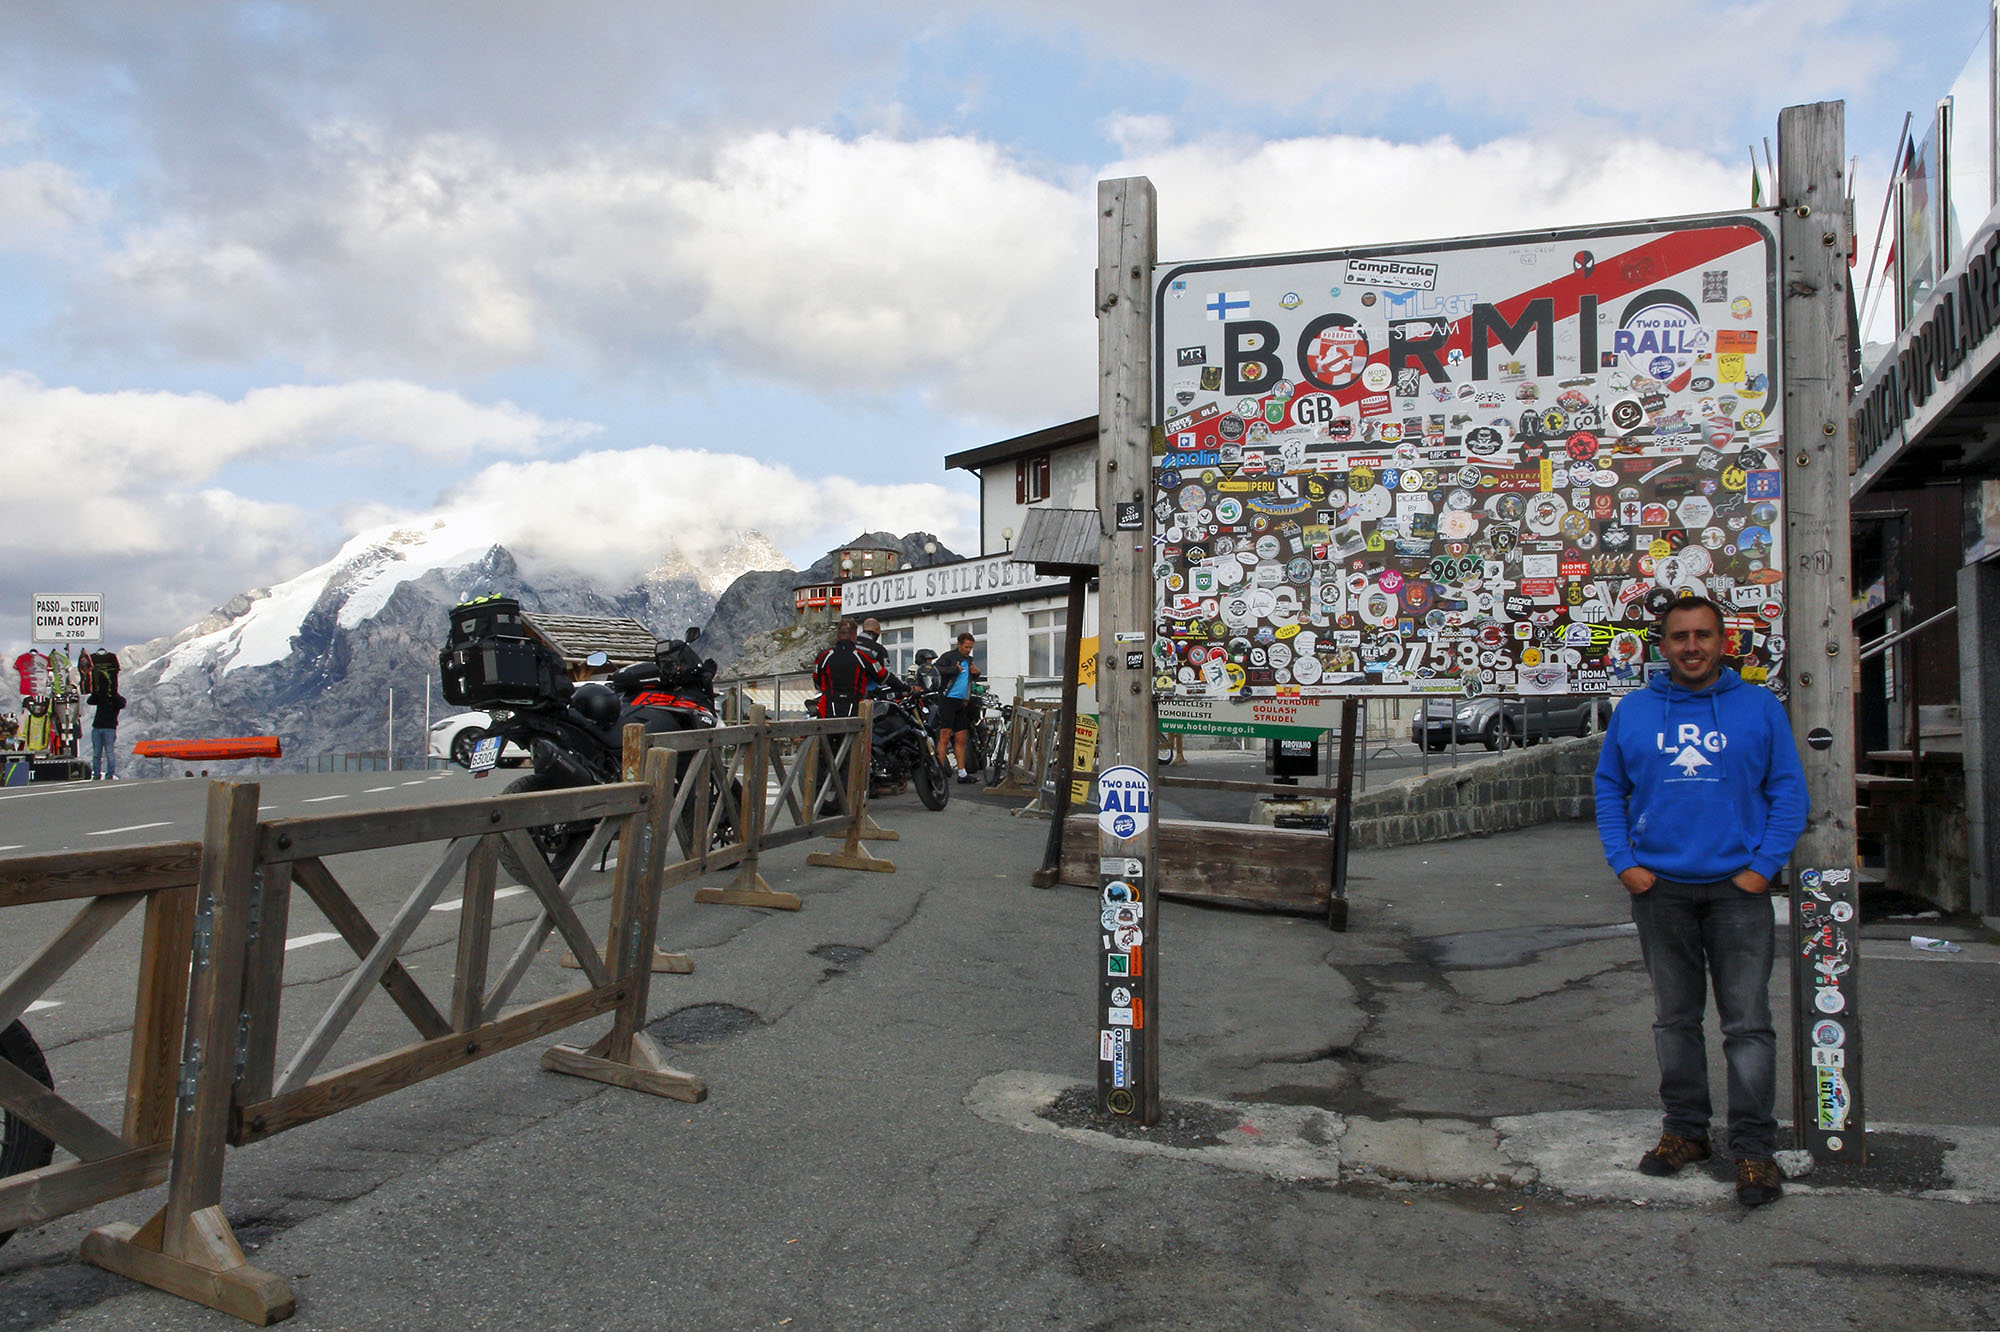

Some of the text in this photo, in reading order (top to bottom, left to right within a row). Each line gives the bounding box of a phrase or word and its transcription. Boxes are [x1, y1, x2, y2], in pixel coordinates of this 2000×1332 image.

[1348, 259, 1435, 277] CompBrake
[1636, 320, 1661, 328] TWO
[1614, 329, 1705, 358] RALL
[1181, 347, 1203, 360] MTR
[1856, 230, 2000, 469] BANCA POPOLARE
[1297, 396, 1333, 425] GB
[1429, 451, 1447, 459] MPC
[1349, 458, 1380, 467] MOTUL
[1251, 481, 1276, 492] PERU
[1499, 480, 1541, 488] On Tour
[1397, 494, 1427, 502] DICKED
[1430, 559, 1457, 581] 96
[855, 560, 1060, 607] HOTEL STILFSER
[1736, 588, 1762, 602] MTR
[1508, 596, 1533, 606] DICKE
[37, 601, 60, 612] PASSO
[71, 601, 99, 612] STELVIO
[1505, 604, 1524, 612] EIER
[37, 616, 99, 627] CIMA COPPI
[66, 630, 85, 638] 2760
[1361, 649, 1379, 657] KLE
[1582, 670, 1607, 679] ROMA
[1583, 682, 1607, 691] CLAN
[1276, 699, 1320, 707] VERDURE
[1159, 709, 1212, 719] TOMOBILISTI
[1252, 705, 1297, 714] GOULASH
[1254, 714, 1295, 723] STRUDEL
[1162, 722, 1255, 734] www.hotelperego.it
[1281, 740, 1312, 750] PIROVANO
[1102, 780, 1147, 789] TWO BALL
[1098, 790, 1153, 813] ALL
